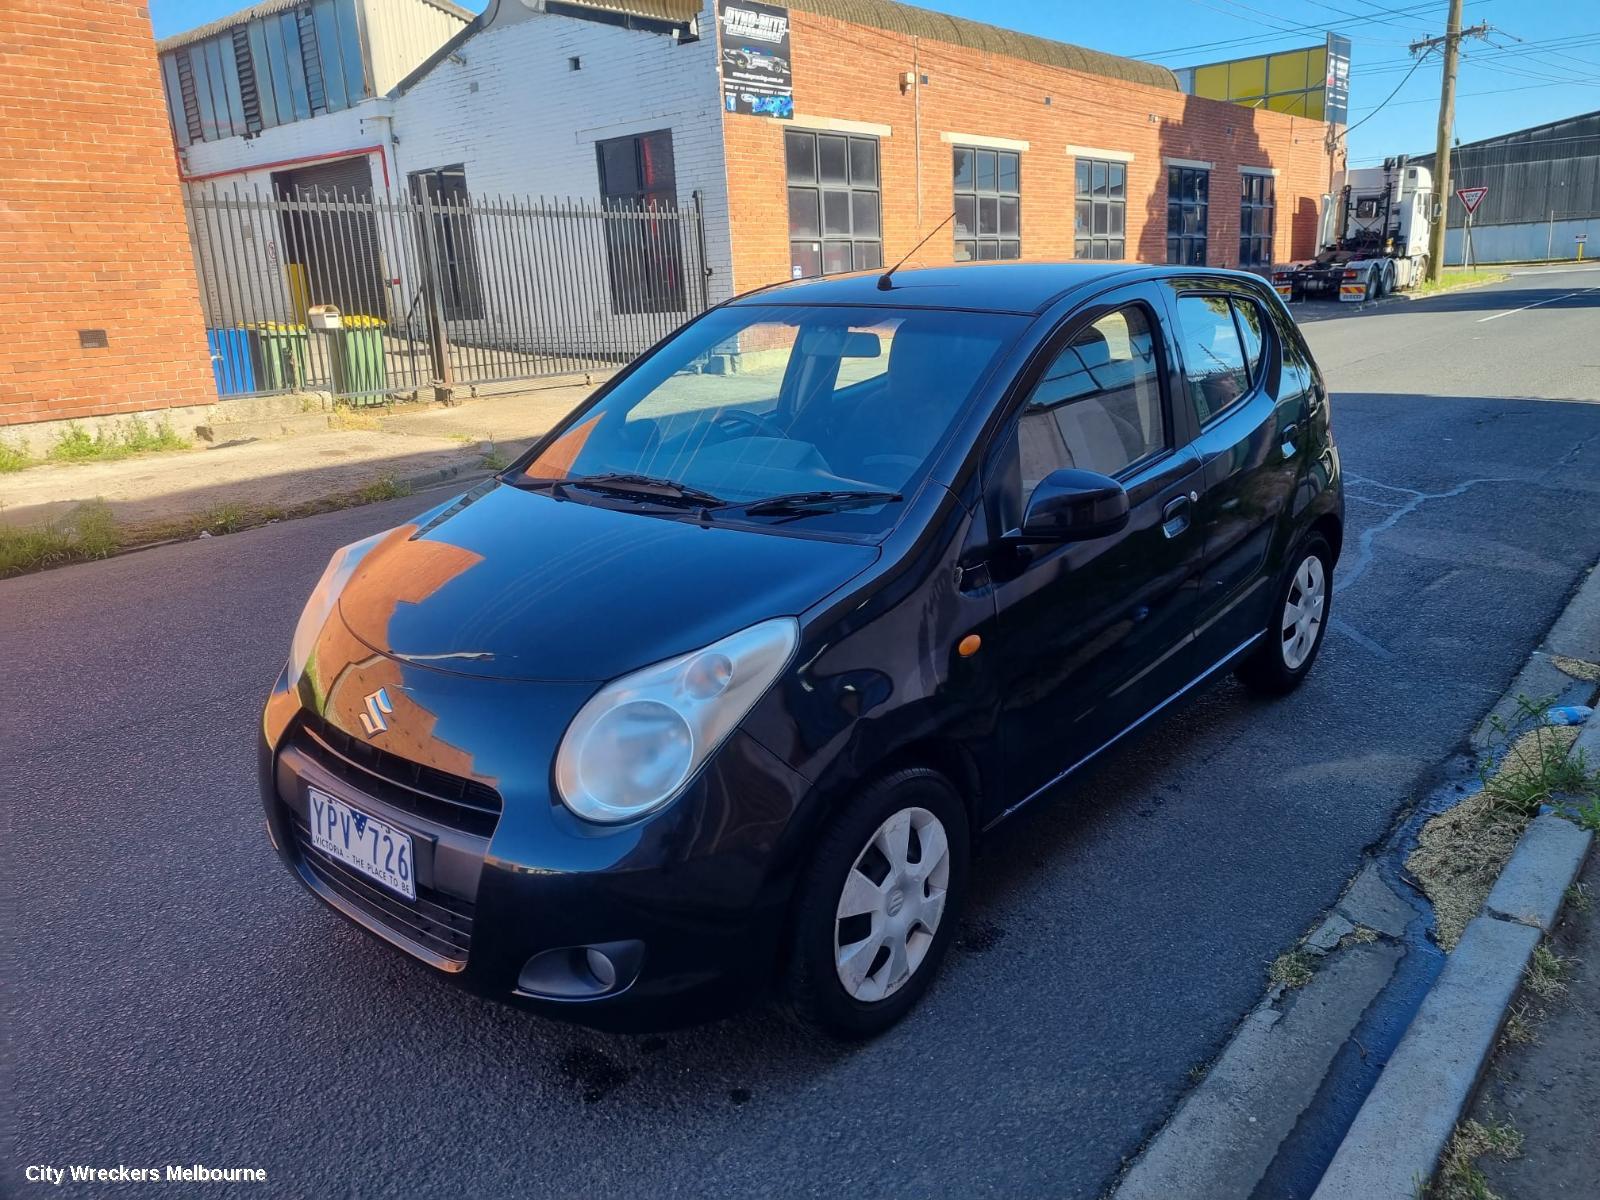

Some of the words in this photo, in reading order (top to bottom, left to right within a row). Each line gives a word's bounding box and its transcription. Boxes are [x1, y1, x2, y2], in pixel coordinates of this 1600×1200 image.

[725, 8, 786, 32] DYNO-MITE
[312, 797, 351, 849] YPV
[368, 826, 408, 881] 726
[315, 835, 344, 857] VICTORIA
[352, 855, 365, 868] THE
[367, 862, 387, 881] PLACE
[389, 875, 398, 887] TO
[401, 882, 410, 893] BE
